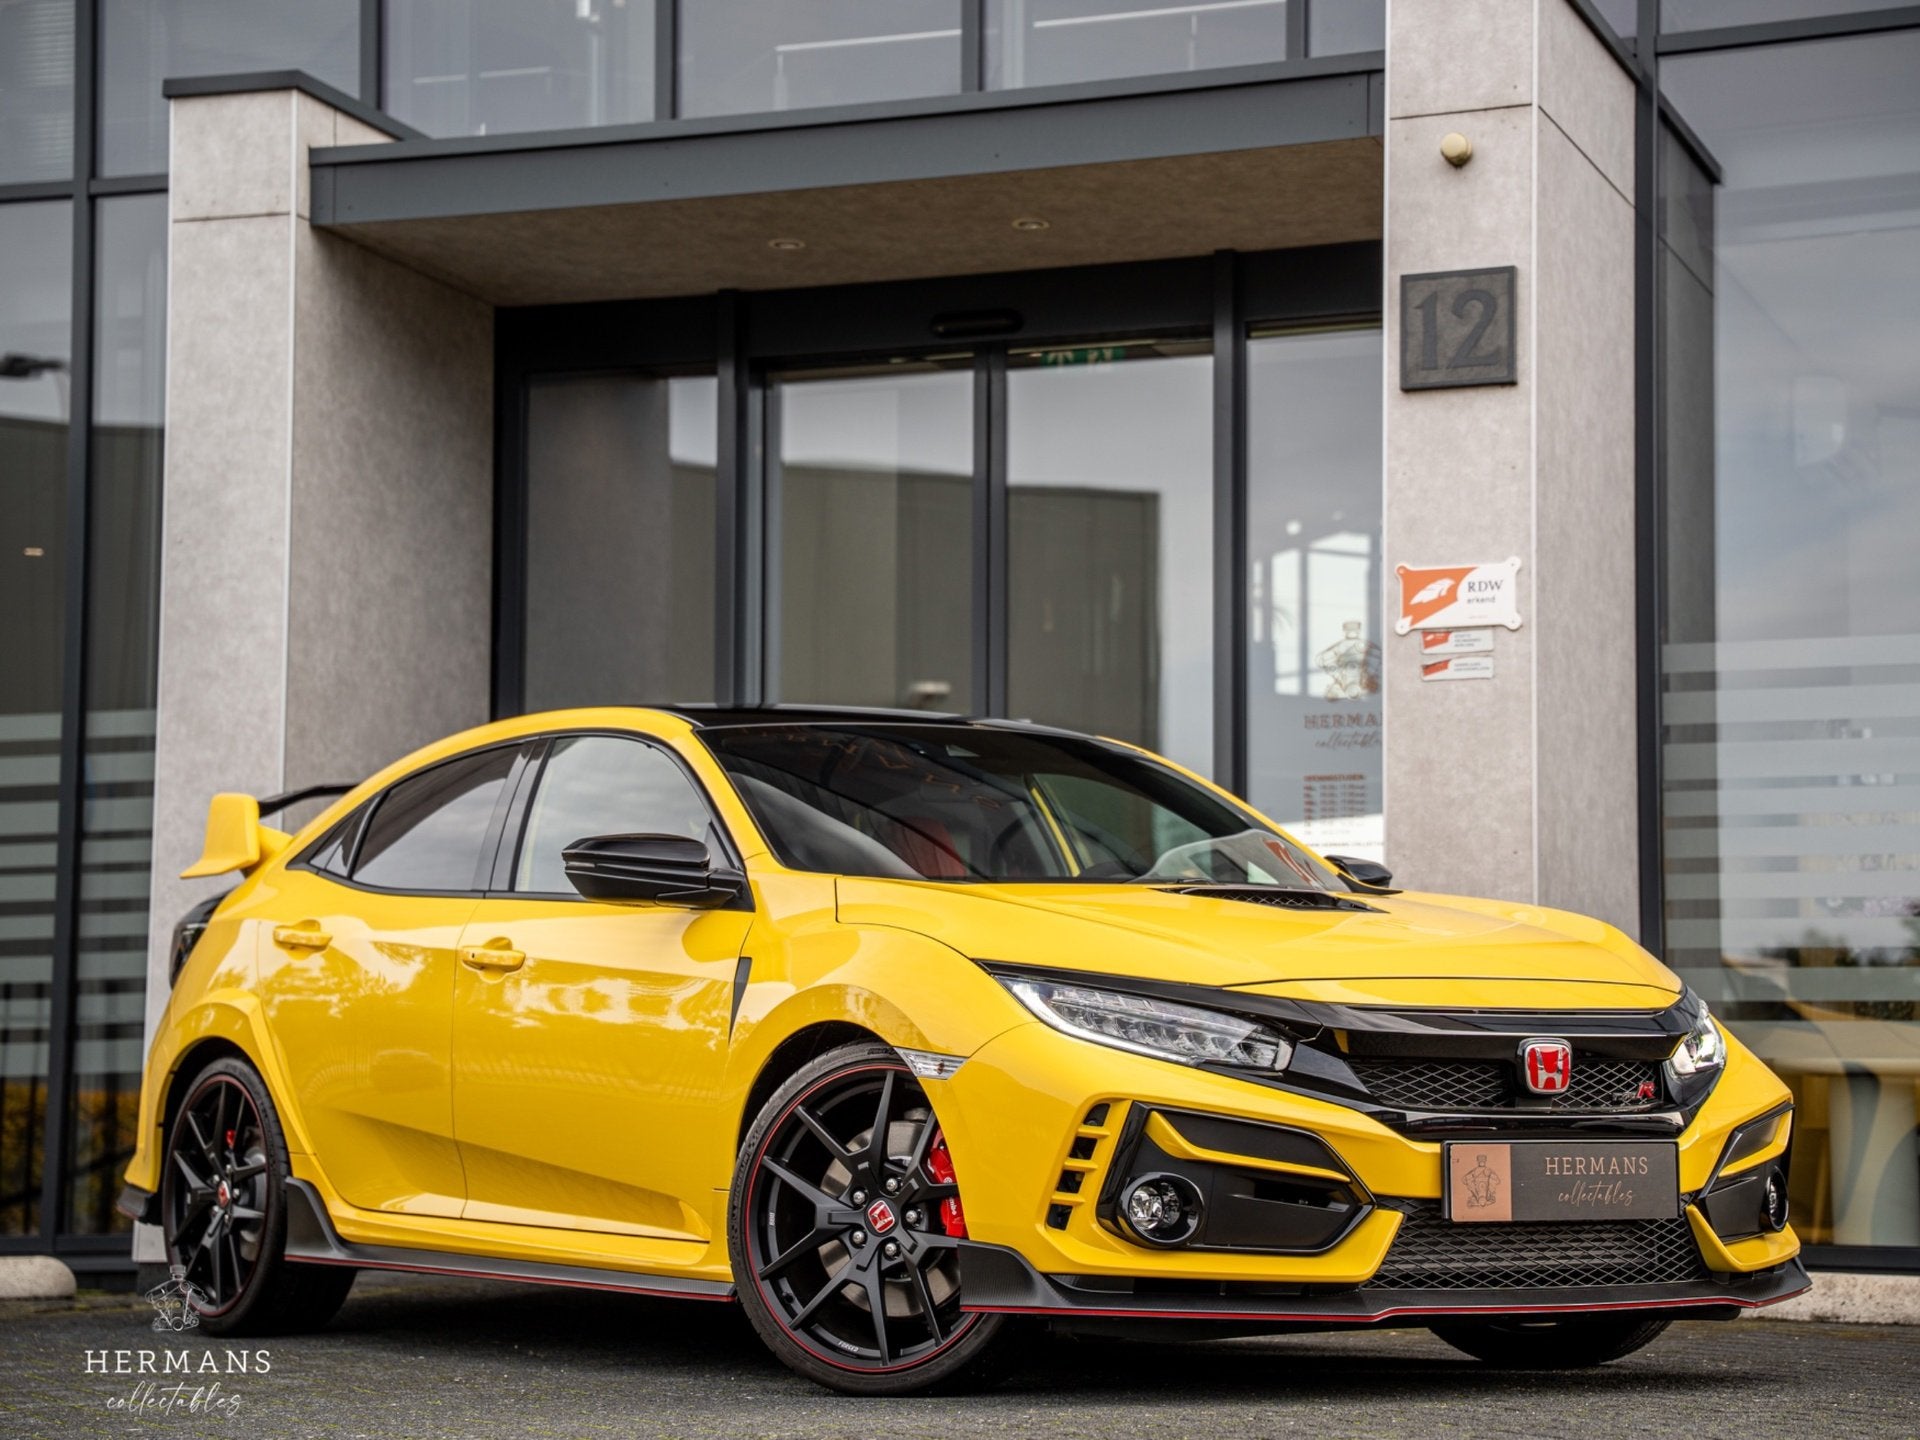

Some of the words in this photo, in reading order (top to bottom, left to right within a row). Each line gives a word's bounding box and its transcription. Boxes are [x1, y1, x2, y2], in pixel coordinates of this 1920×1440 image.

[1414, 288, 1503, 371] 12
[1467, 579, 1503, 593] RDW
[1304, 711, 1383, 729] HERMA
[1545, 1156, 1649, 1176] HERMANS
[1558, 1180, 1635, 1208] collectables
